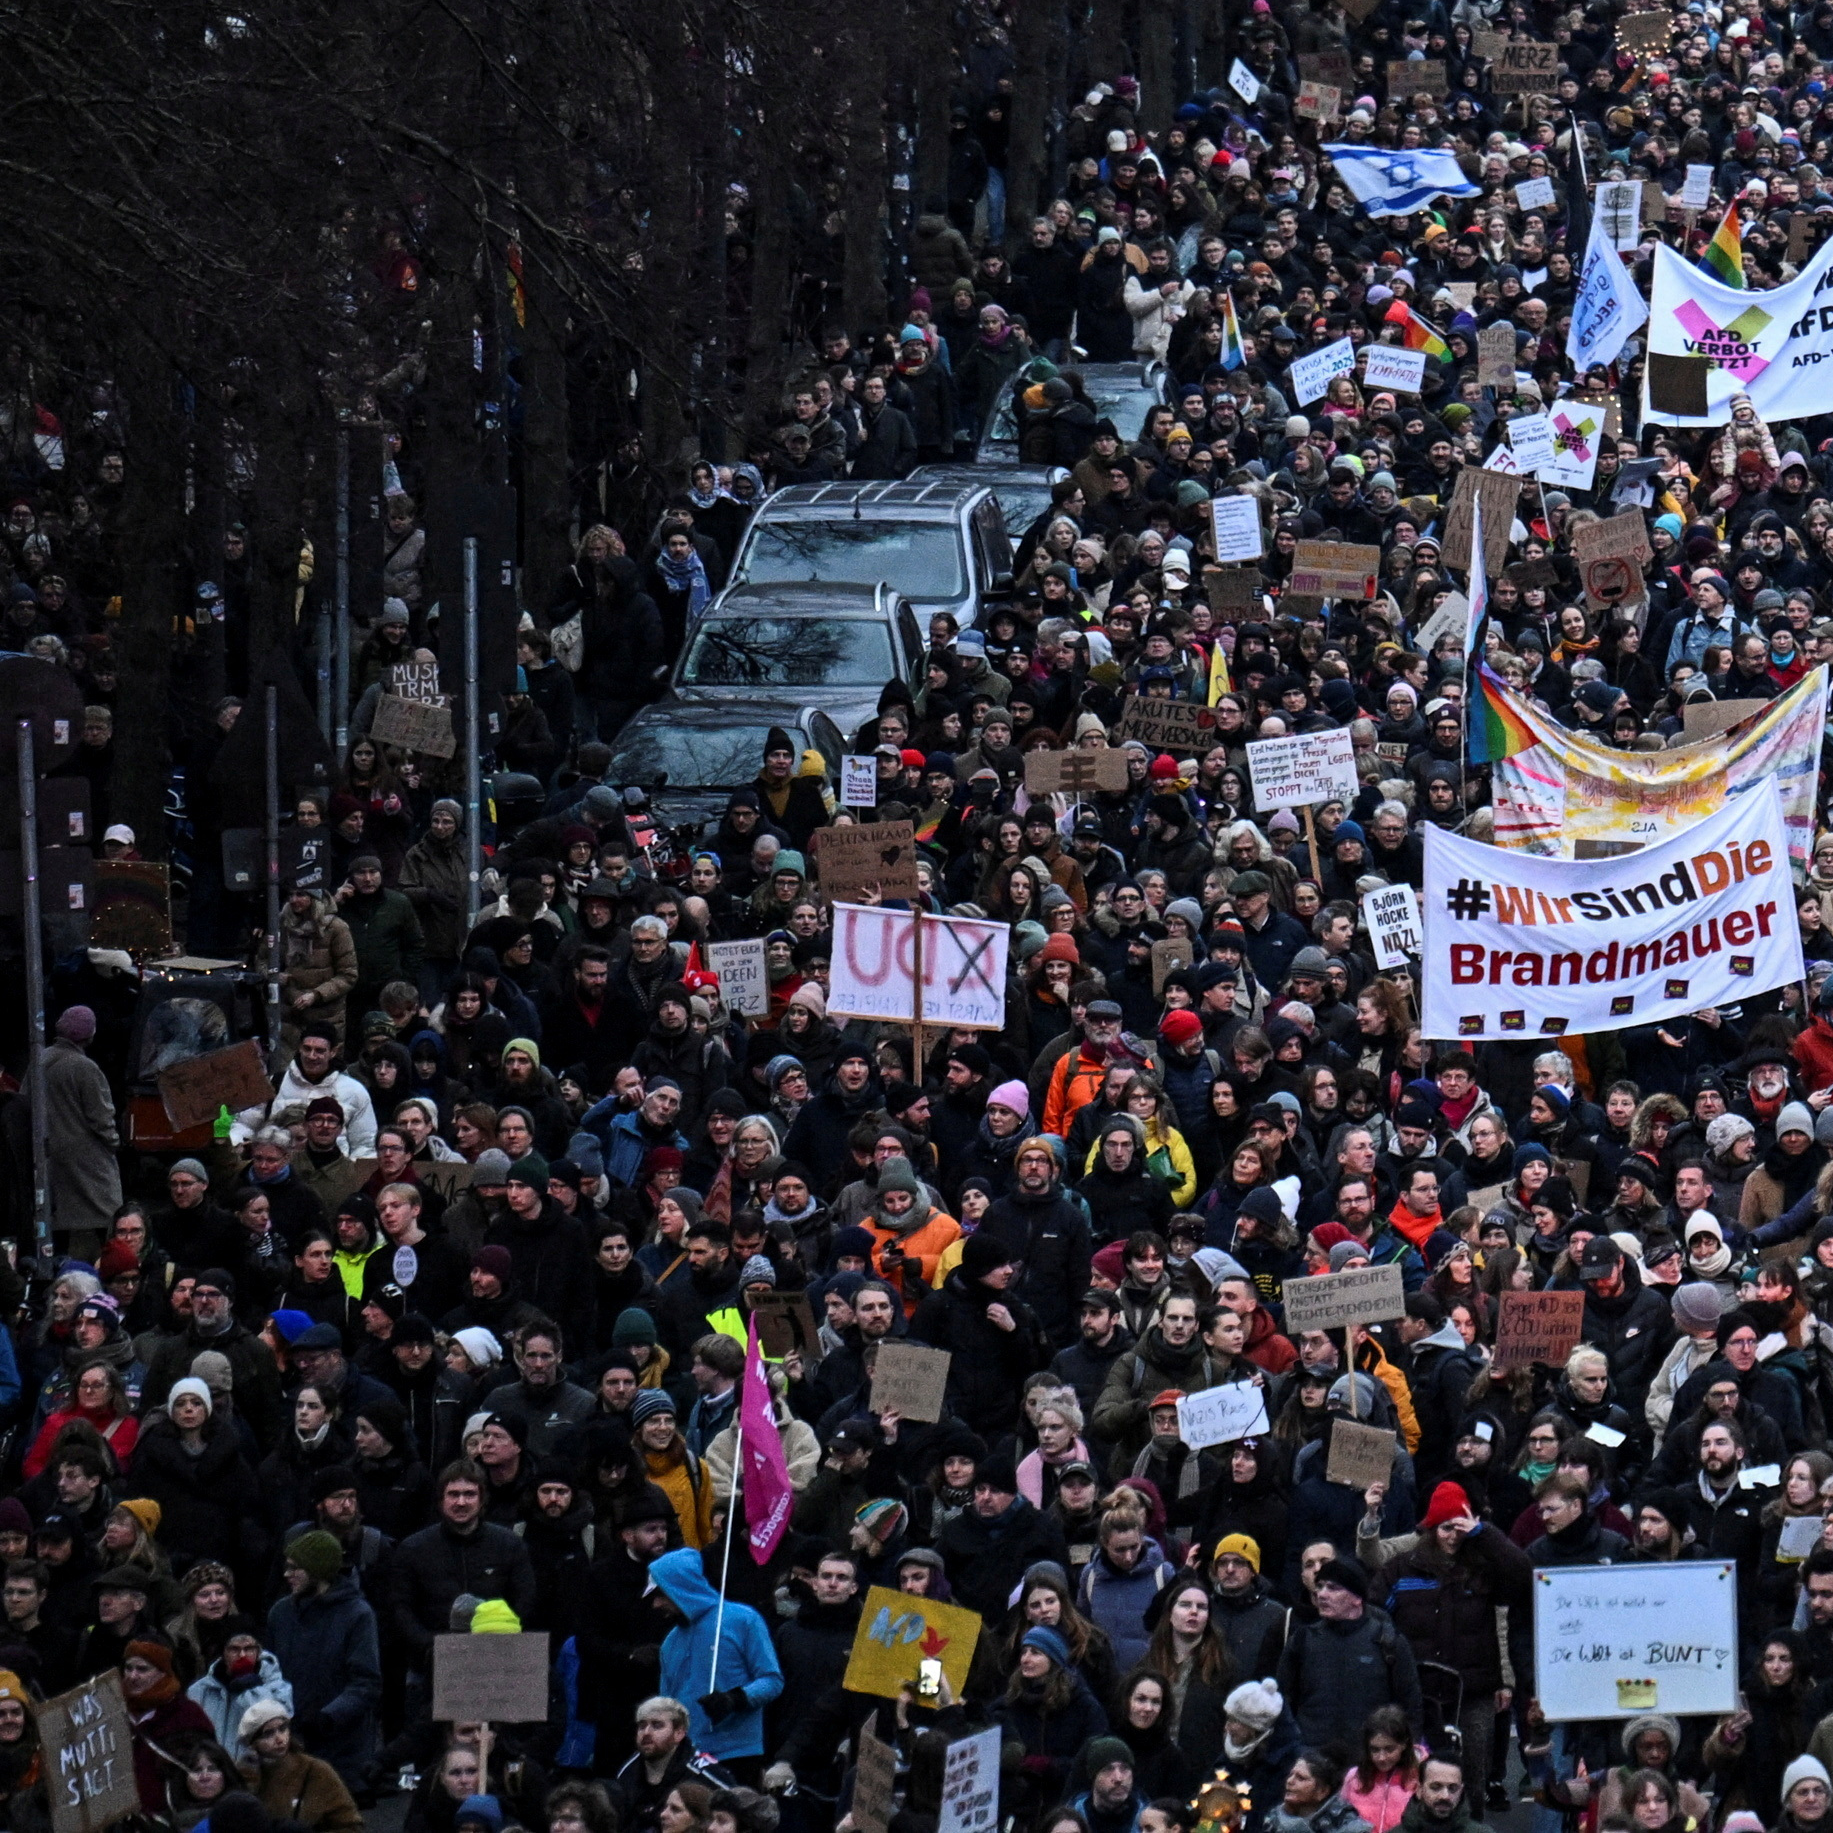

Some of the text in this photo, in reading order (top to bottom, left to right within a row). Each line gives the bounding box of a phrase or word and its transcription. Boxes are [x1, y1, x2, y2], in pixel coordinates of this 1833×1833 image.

[1502, 45, 1552, 69] MERZ
[1702, 328, 1742, 343] AFD
[1683, 338, 1762, 356] VERBOT
[1132, 701, 1197, 723] AKUTES
[1266, 784, 1302, 801] STOPPT
[1371, 890, 1406, 912] BJÖRN
[1375, 906, 1410, 926] HÖCKE
[1381, 932, 1416, 953] NAZI
[1449, 900, 1777, 987] Brandmauer
[717, 966, 758, 985] IDEEN
[1548, 1642, 1714, 1666] Die Welt ist BUNT
[69, 1692, 104, 1727] WAS
[61, 1724, 117, 1775] MUTTI
